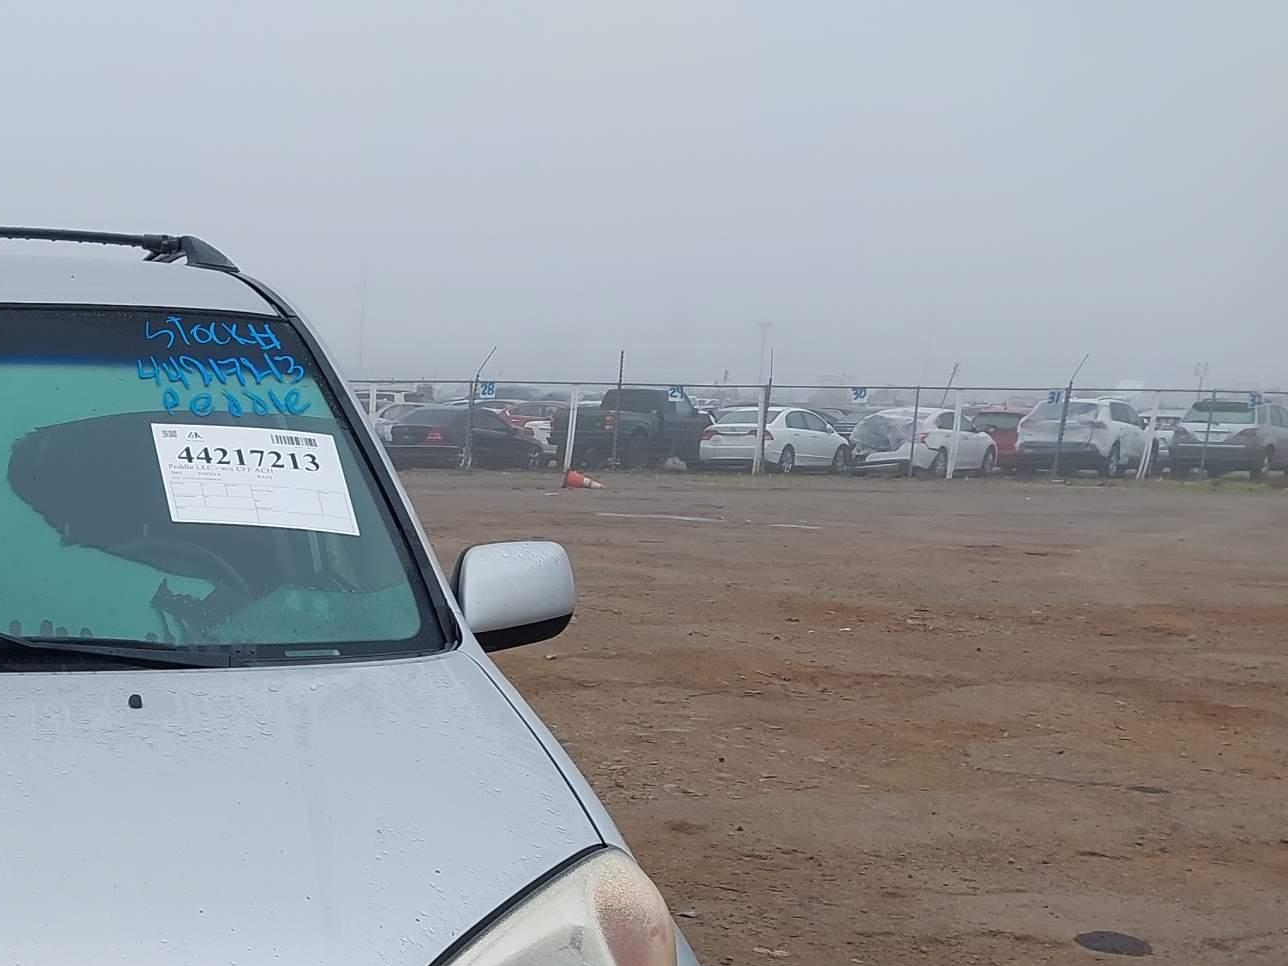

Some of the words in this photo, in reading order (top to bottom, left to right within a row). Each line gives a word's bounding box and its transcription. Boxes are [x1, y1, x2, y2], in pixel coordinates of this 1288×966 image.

[481, 382, 495, 396] 28
[852, 387, 867, 400] 30
[1047, 391, 1061, 404] 31
[177, 446, 320, 472] 44217213
